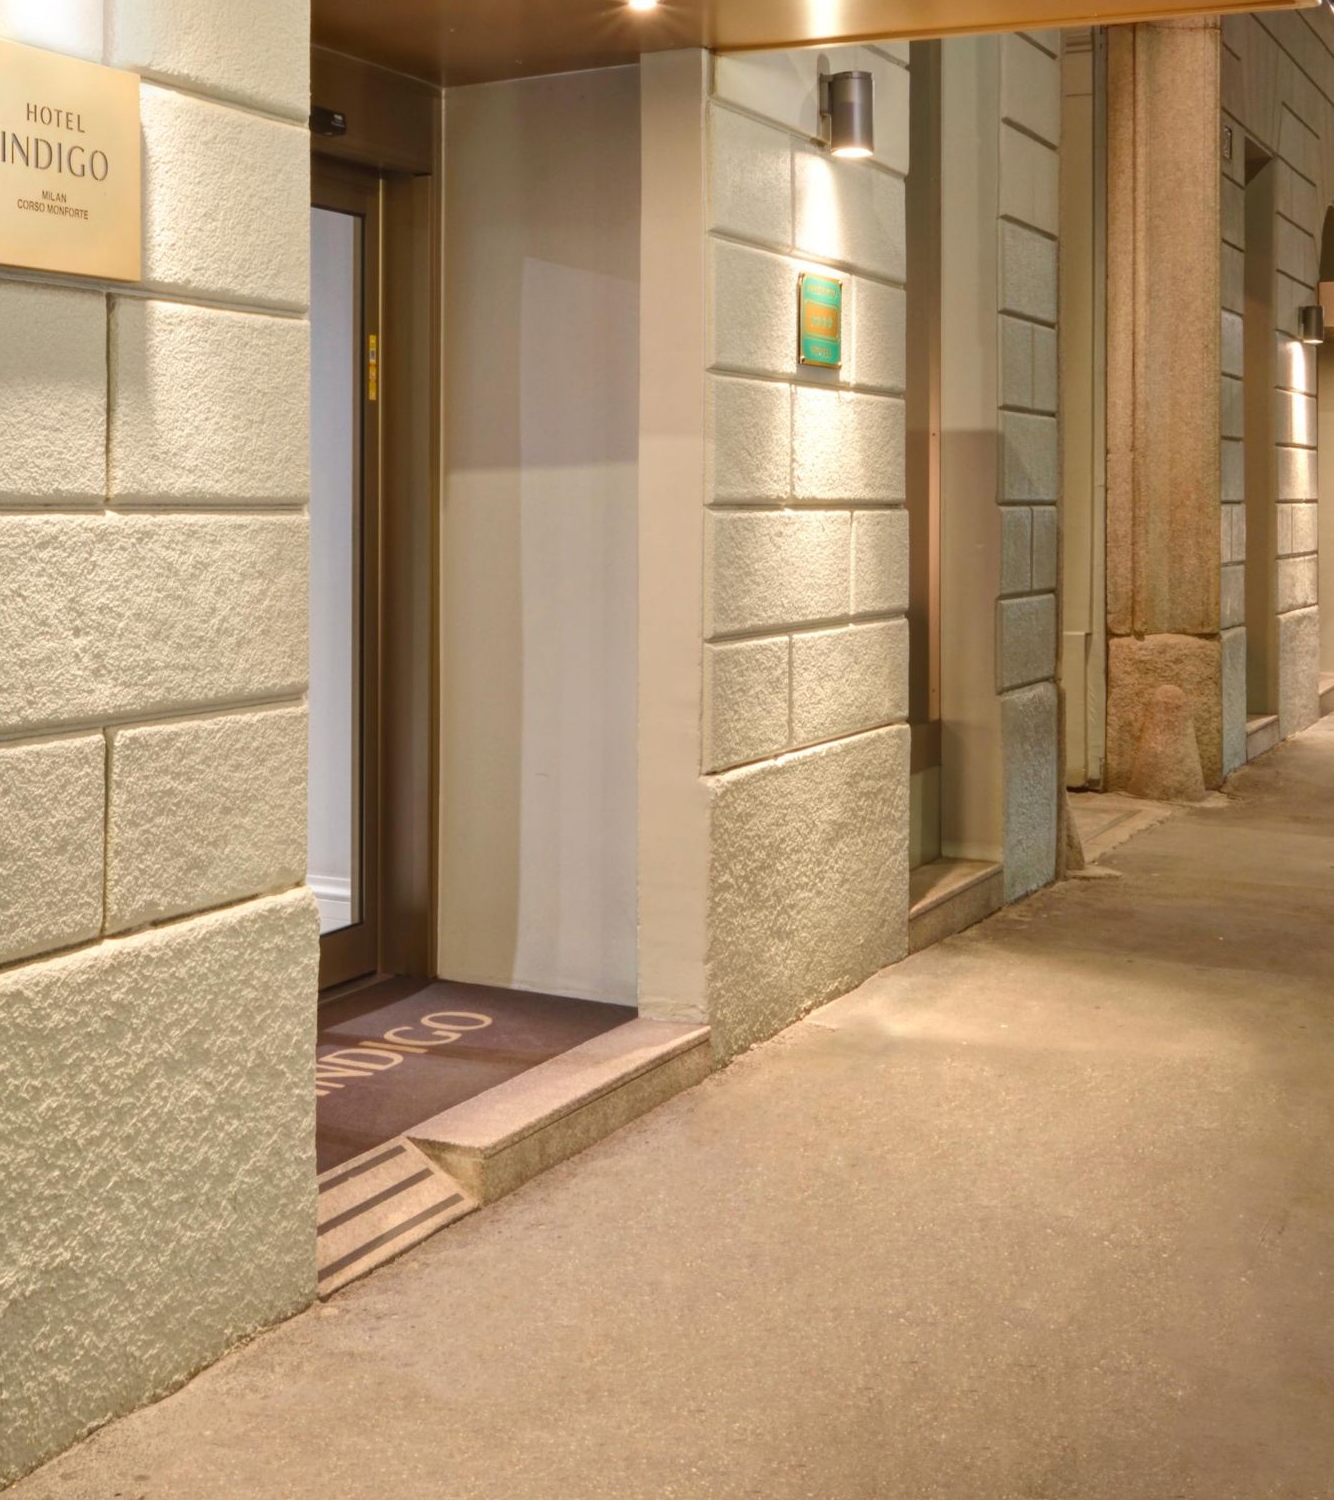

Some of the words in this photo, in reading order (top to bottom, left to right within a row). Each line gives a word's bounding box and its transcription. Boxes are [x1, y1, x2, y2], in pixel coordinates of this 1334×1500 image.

[26, 102, 85, 133] HOTEL
[1, 130, 109, 182] INDIGO
[17, 198, 46, 213] CORSO
[47, 203, 89, 220] MONFORTE
[41, 189, 67, 204] MILAN
[315, 1011, 493, 1097] NDIGO
